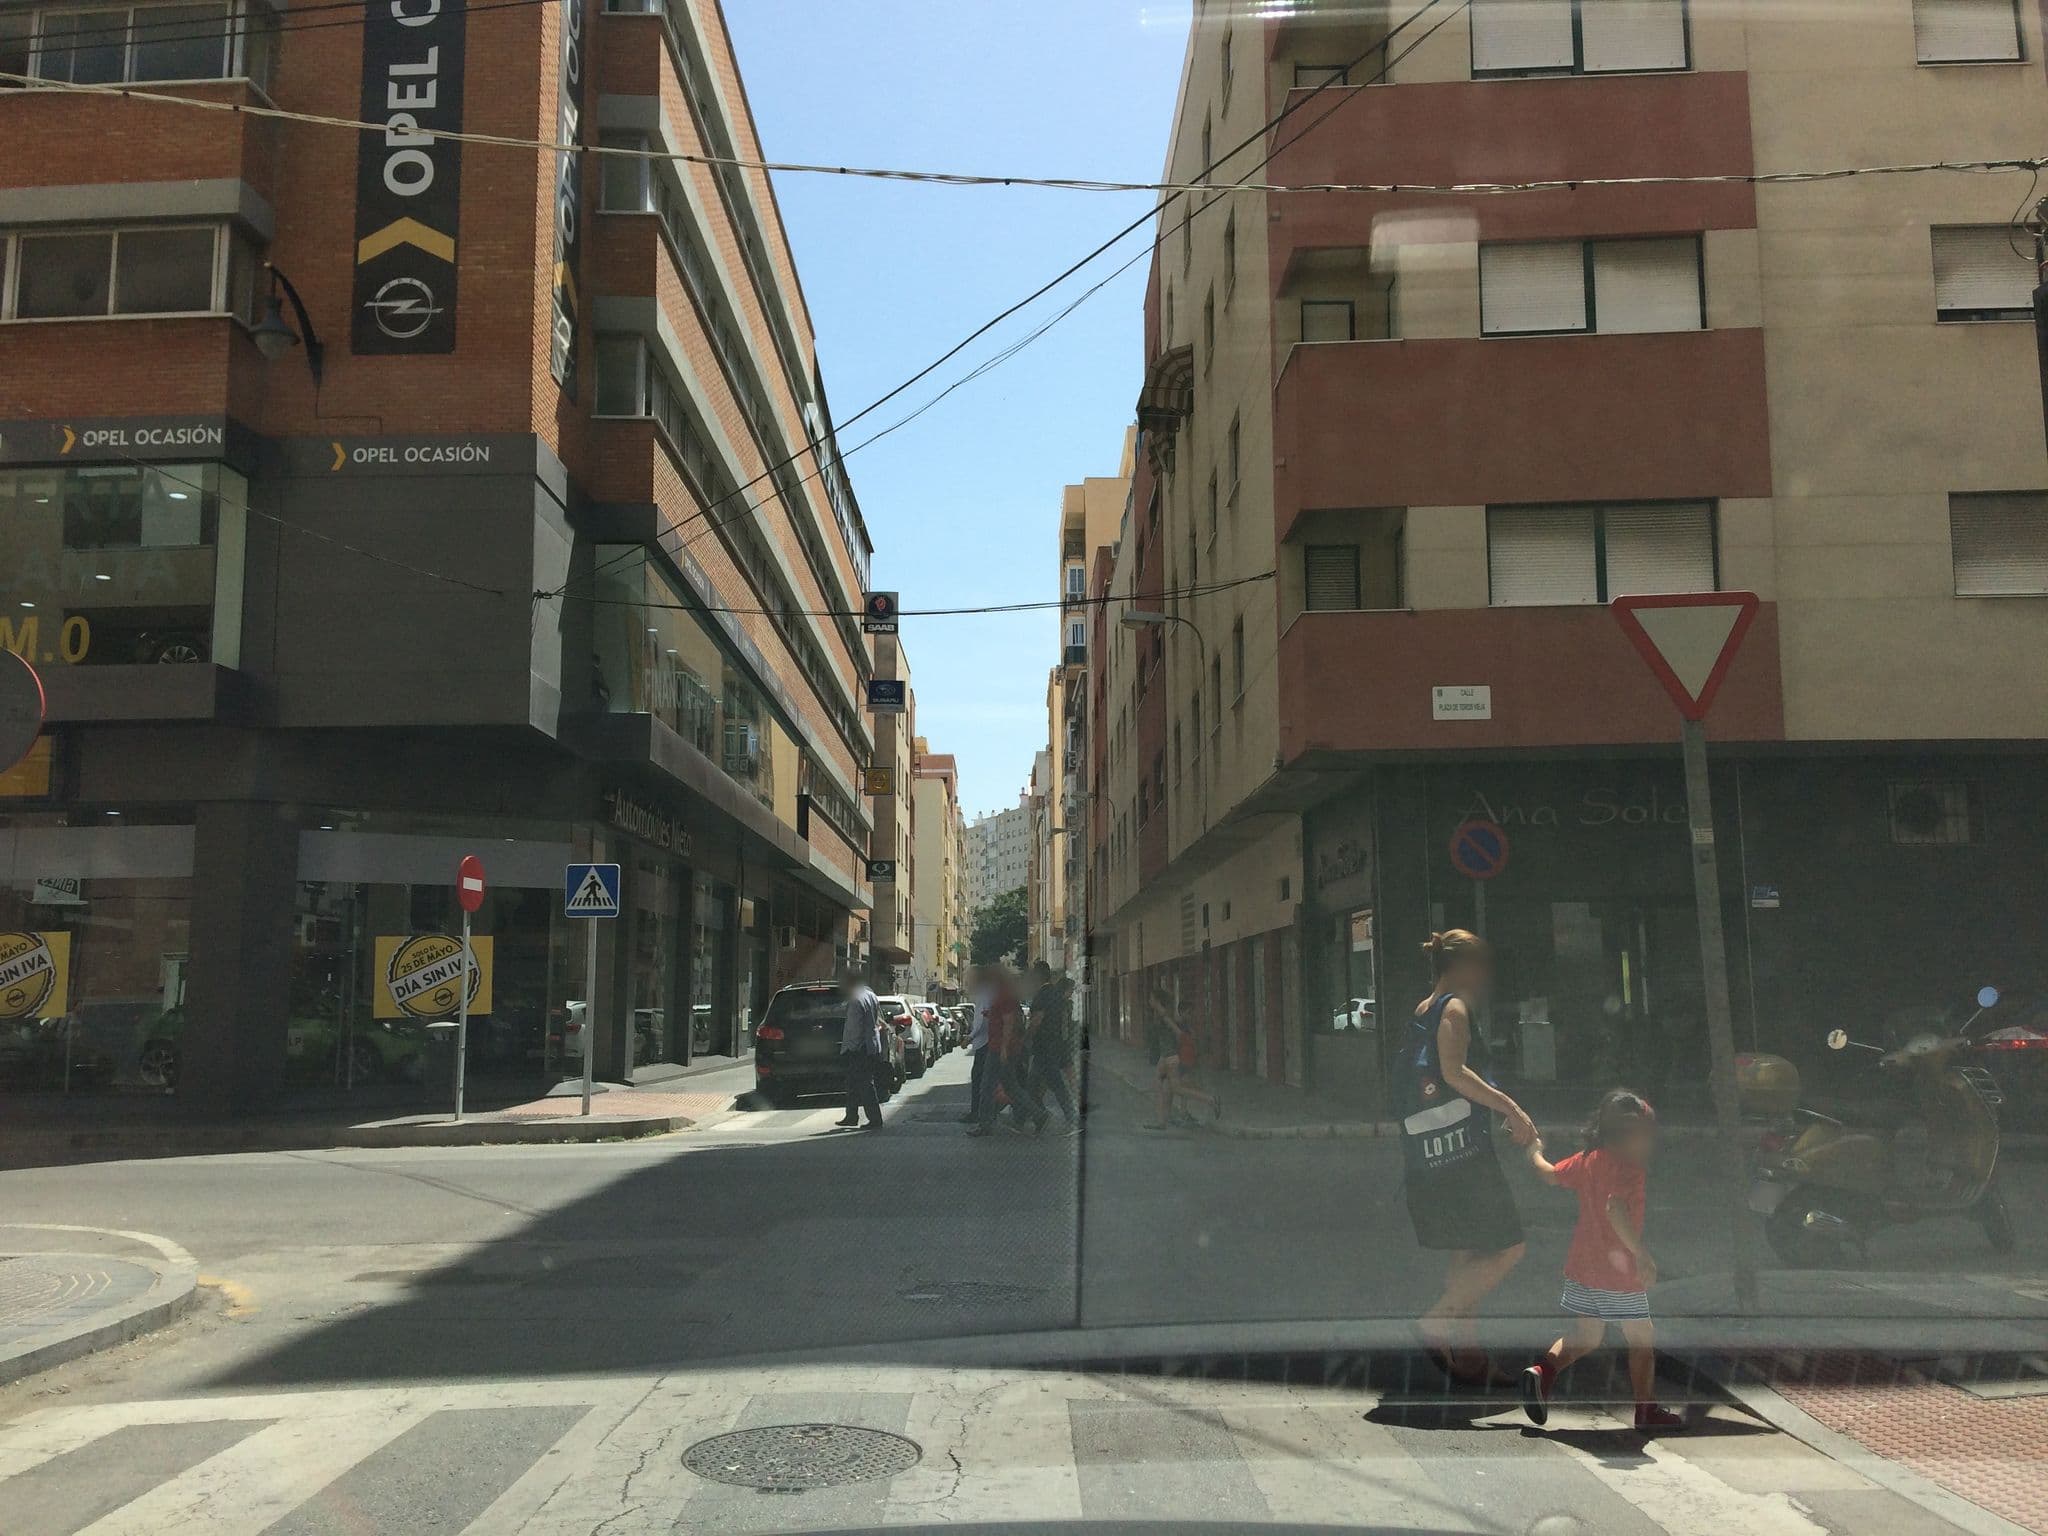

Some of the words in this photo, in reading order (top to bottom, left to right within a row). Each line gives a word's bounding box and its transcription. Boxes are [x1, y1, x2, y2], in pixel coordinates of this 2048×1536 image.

[383, 46, 439, 197] OPEL
[83, 430, 129, 446] OPEL
[135, 424, 222, 445] OCASIÓN
[353, 447, 398, 463] OPEL
[404, 443, 490, 463] OCASIÓN
[868, 624, 895, 632] SAAB
[22, 953, 48, 974] IVA
[401, 964, 412, 974] 25
[413, 958, 426, 968] DE
[427, 945, 453, 961] MAYO
[411, 948, 429, 959] SOLO
[394, 976, 422, 998] DÍA
[422, 966, 447, 986] SIN
[448, 959, 473, 975] IV
